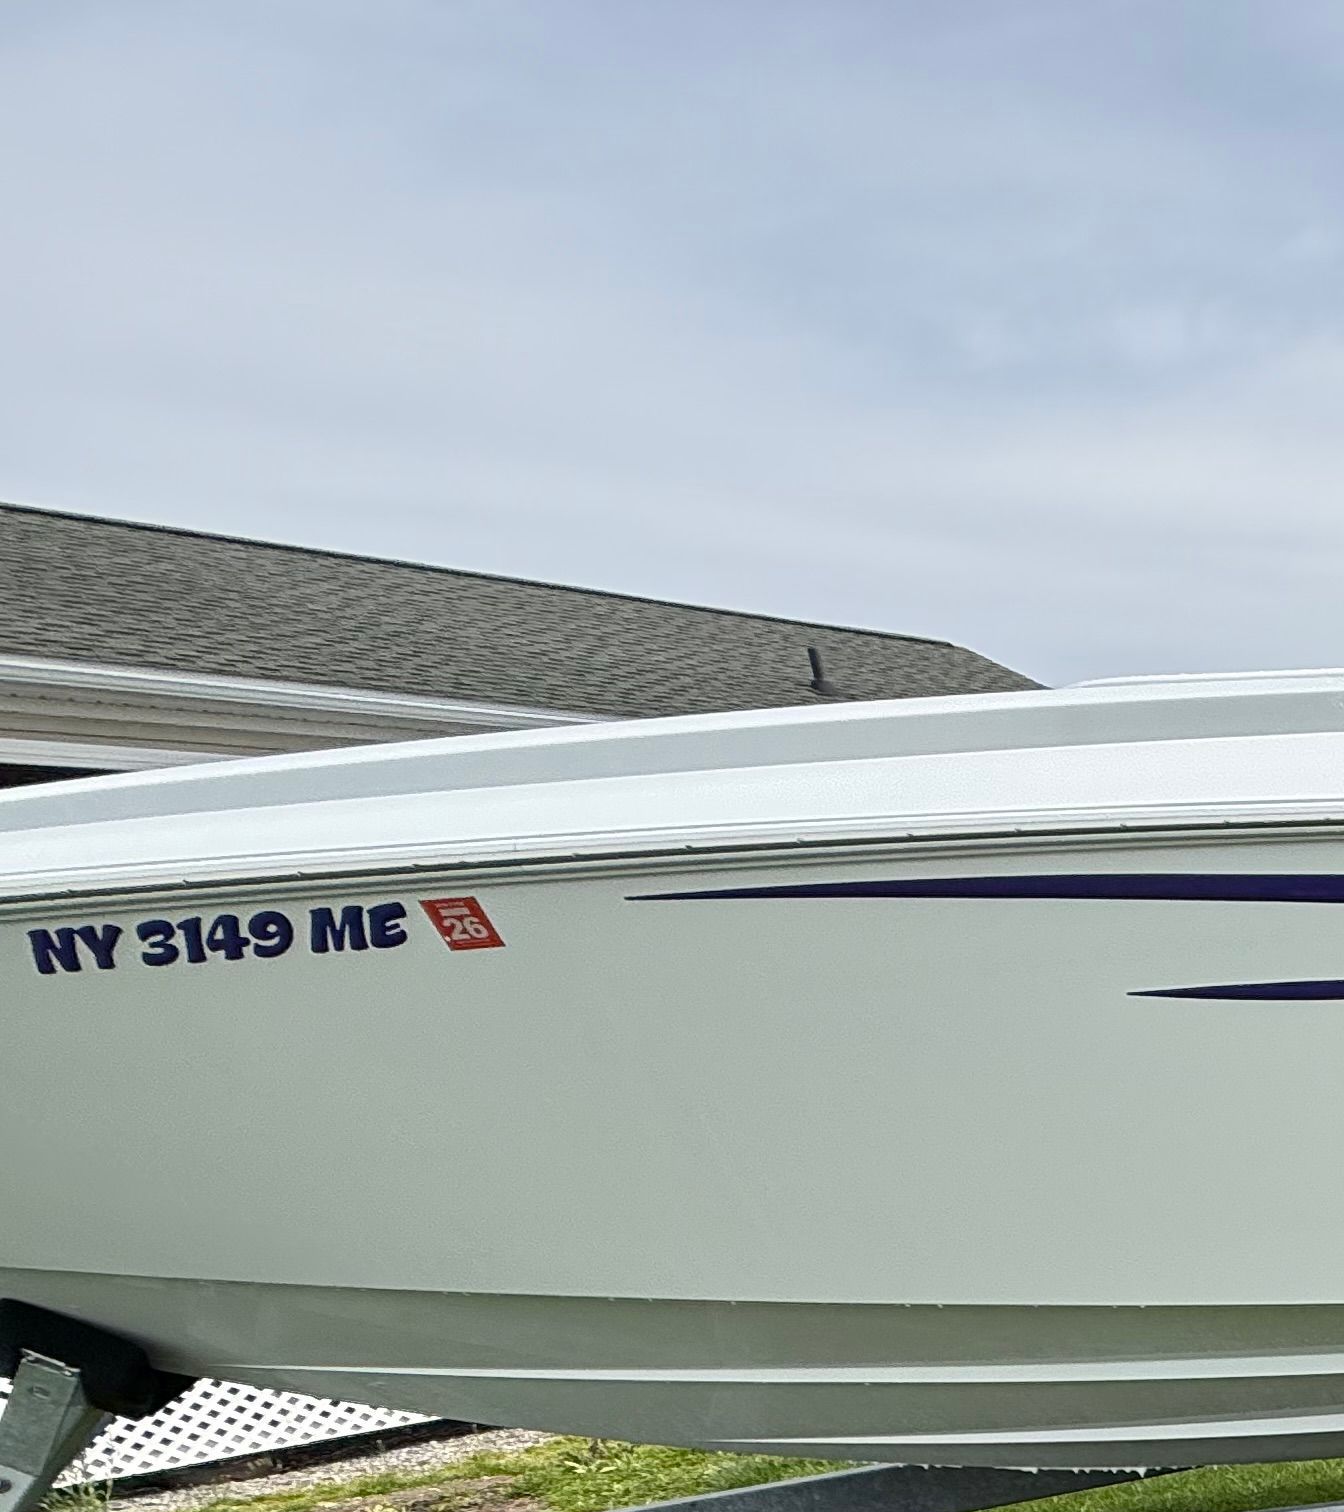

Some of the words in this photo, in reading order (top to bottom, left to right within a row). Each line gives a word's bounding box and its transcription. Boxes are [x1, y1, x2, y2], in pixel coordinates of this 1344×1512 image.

[27, 924, 123, 974] NY
[136, 910, 294, 966] 3149
[309, 901, 408, 953] ME
[442, 916, 489, 941] 26
